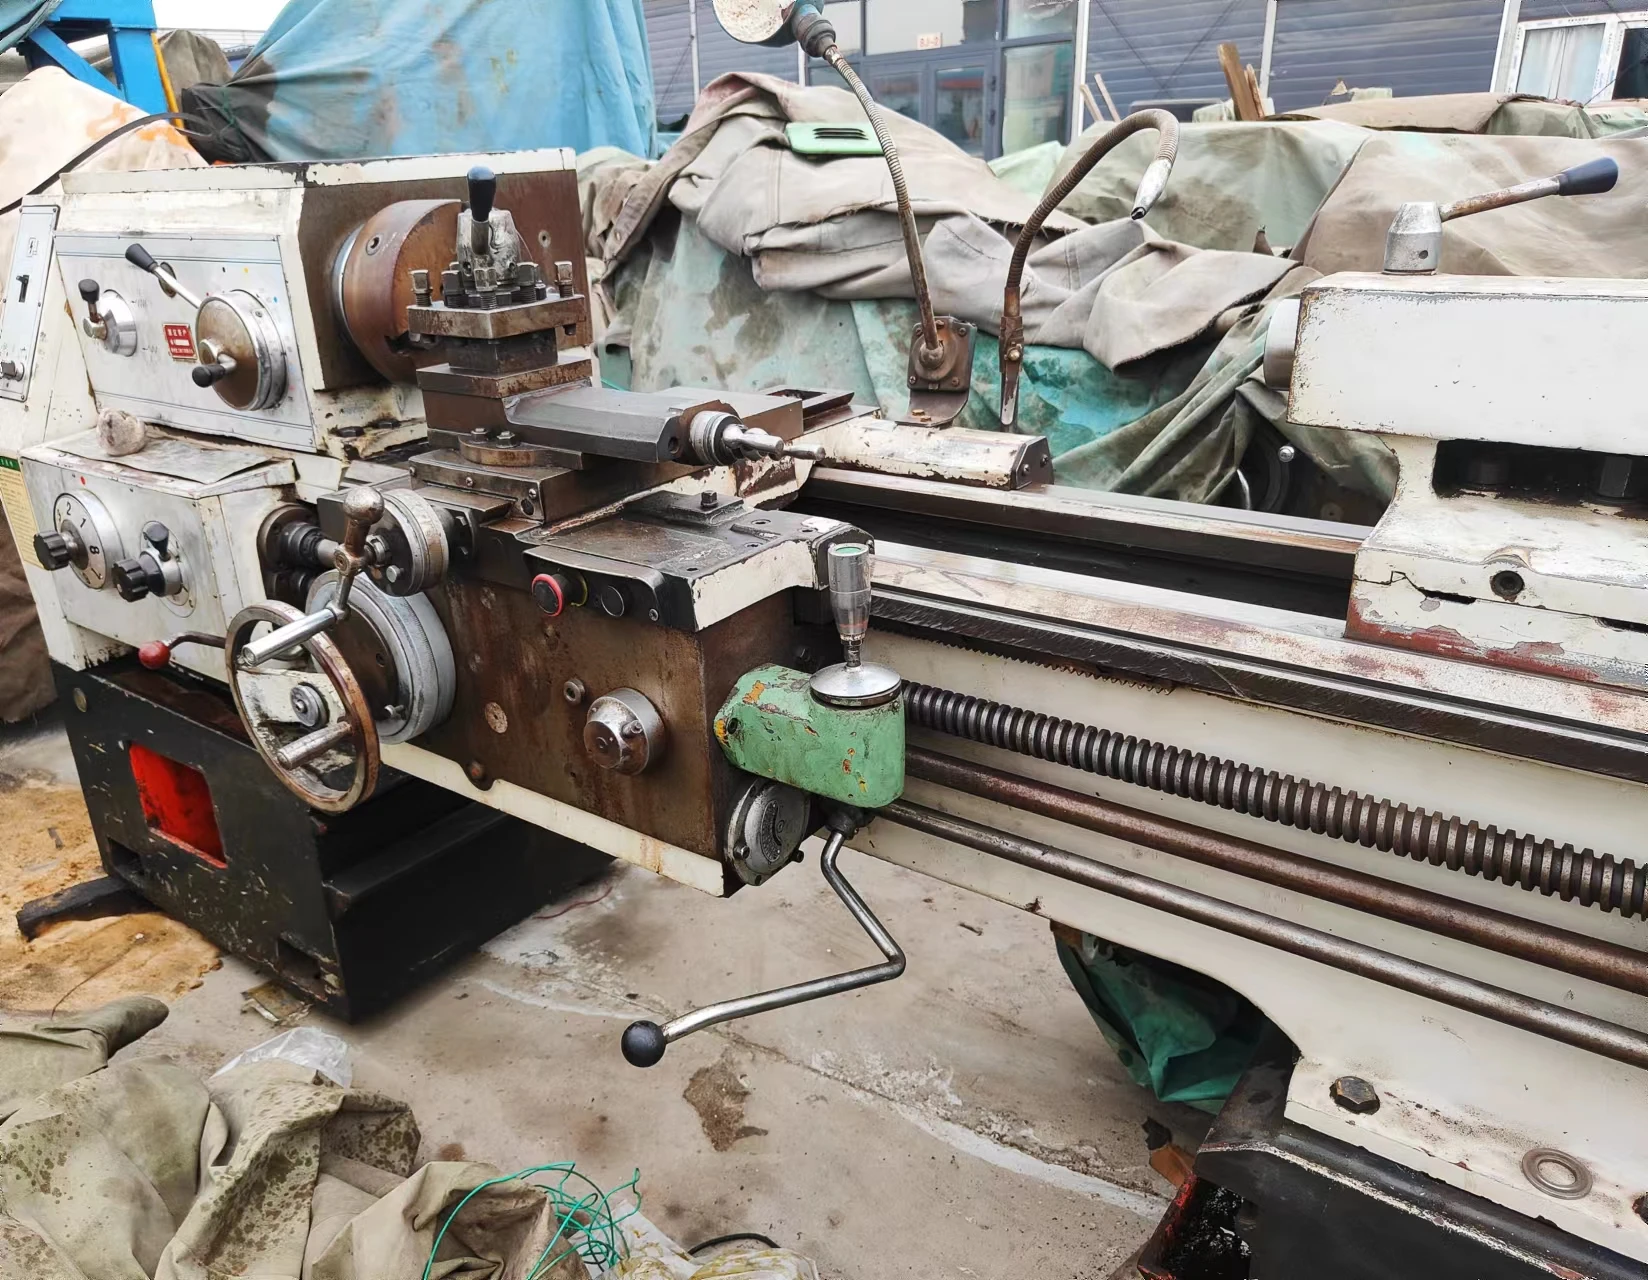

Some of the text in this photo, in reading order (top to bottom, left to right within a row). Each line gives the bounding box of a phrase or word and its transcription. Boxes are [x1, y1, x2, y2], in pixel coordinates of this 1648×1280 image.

[66, 501, 72, 516] 2
[80, 517, 86, 528] 1
[89, 545, 100, 555] 8
